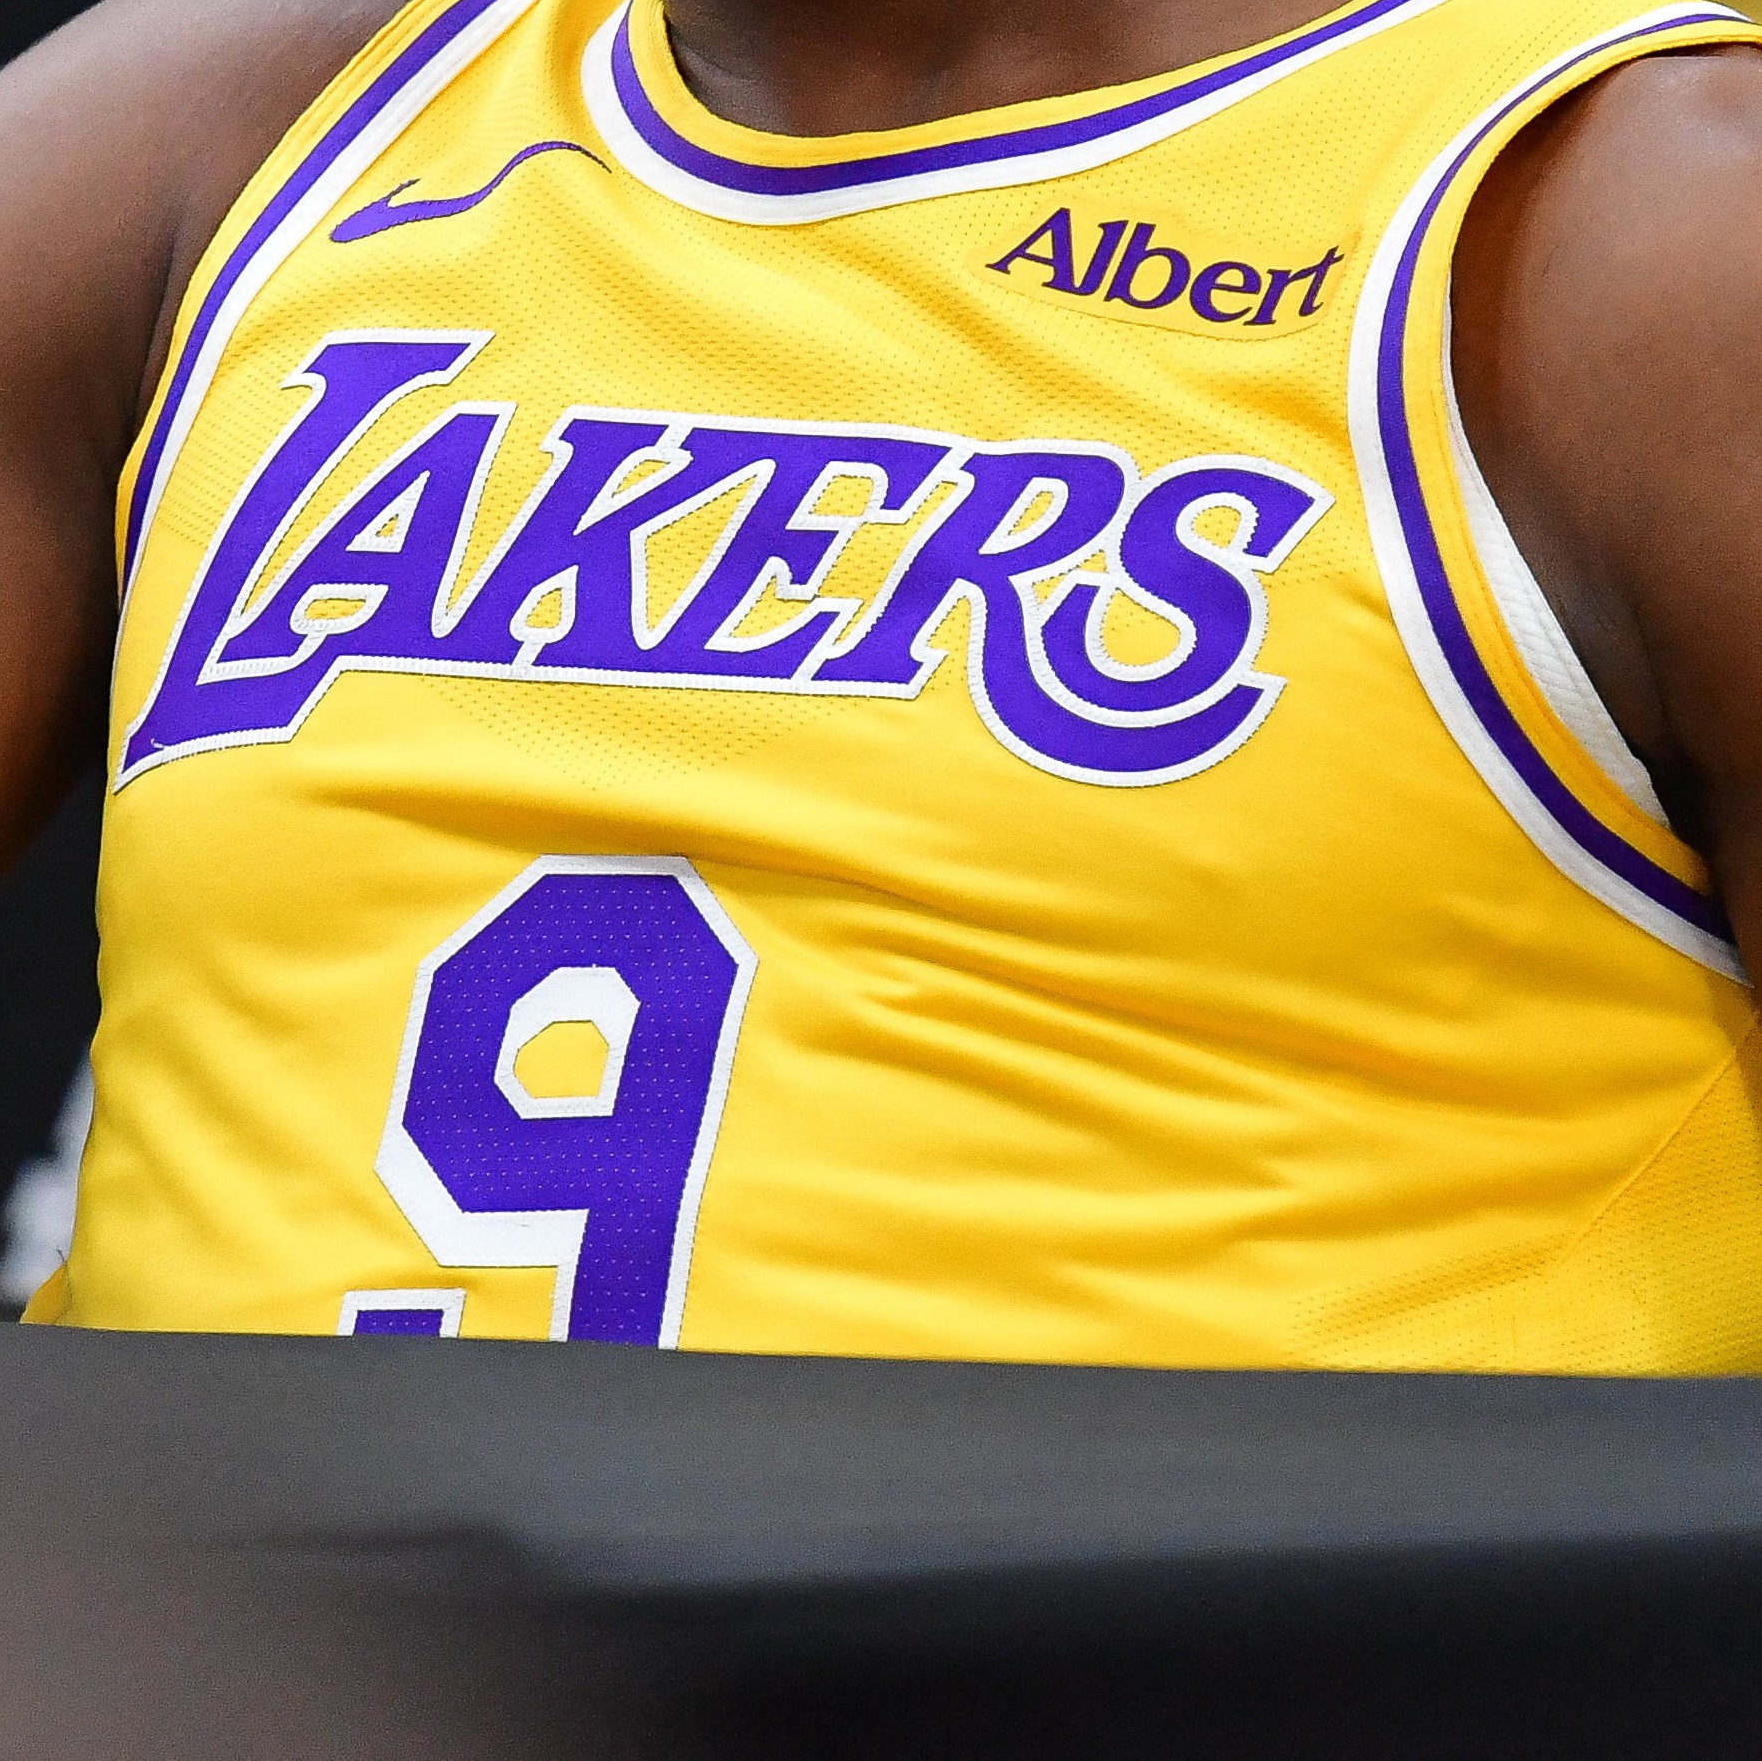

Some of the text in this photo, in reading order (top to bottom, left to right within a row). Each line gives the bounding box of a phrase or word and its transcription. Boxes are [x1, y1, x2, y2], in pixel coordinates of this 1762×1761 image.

[982, 203, 1347, 330] Albert
[114, 330, 1336, 788] LAKERS
[336, 853, 760, 1350] 9
